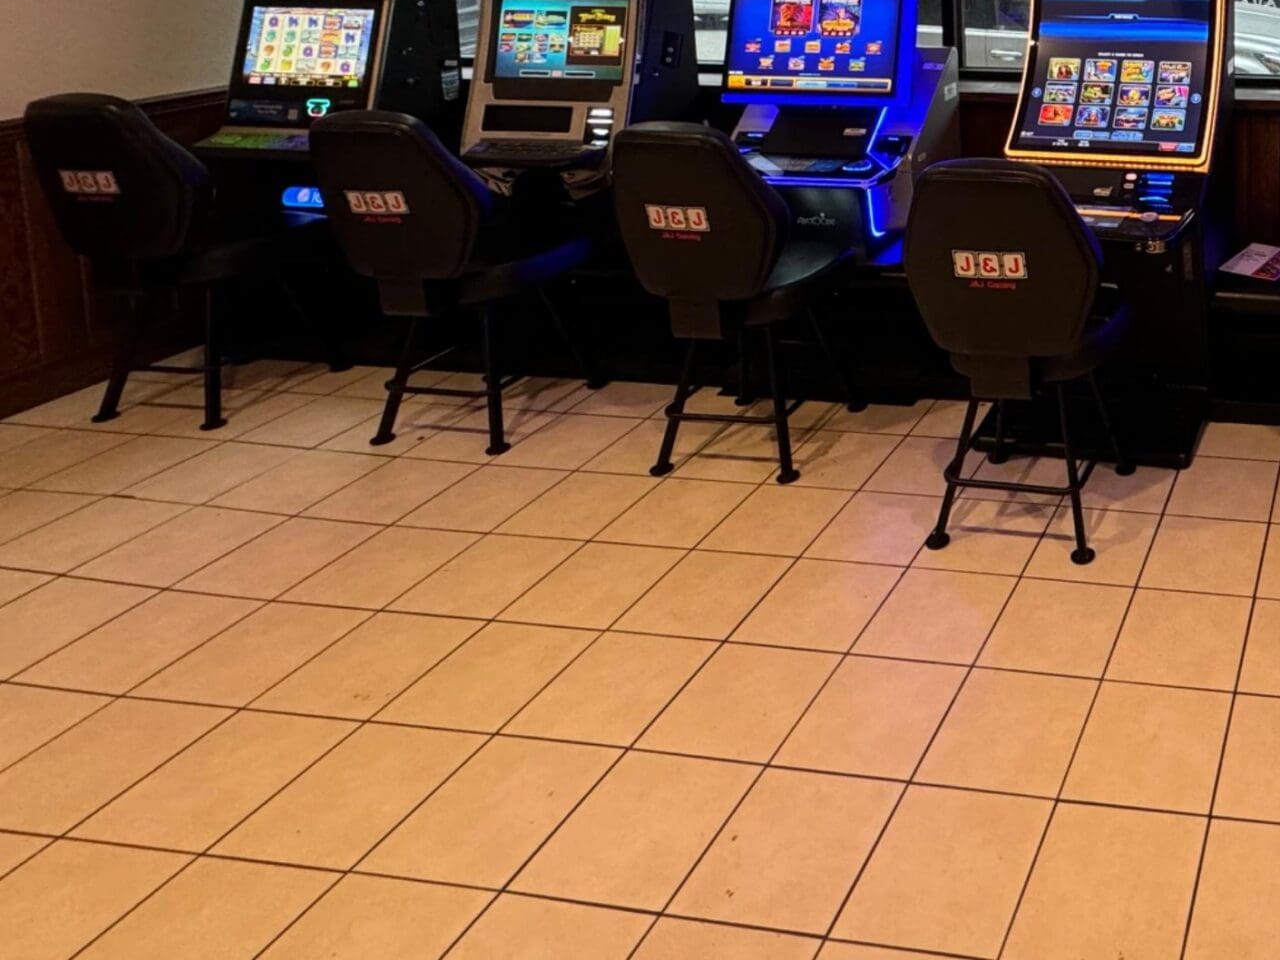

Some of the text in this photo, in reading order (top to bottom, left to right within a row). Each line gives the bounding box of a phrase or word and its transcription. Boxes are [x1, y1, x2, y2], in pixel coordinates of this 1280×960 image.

[351, 193, 403, 211] J&J
[651, 208, 706, 227] J&J
[957, 253, 1022, 276] J&J
